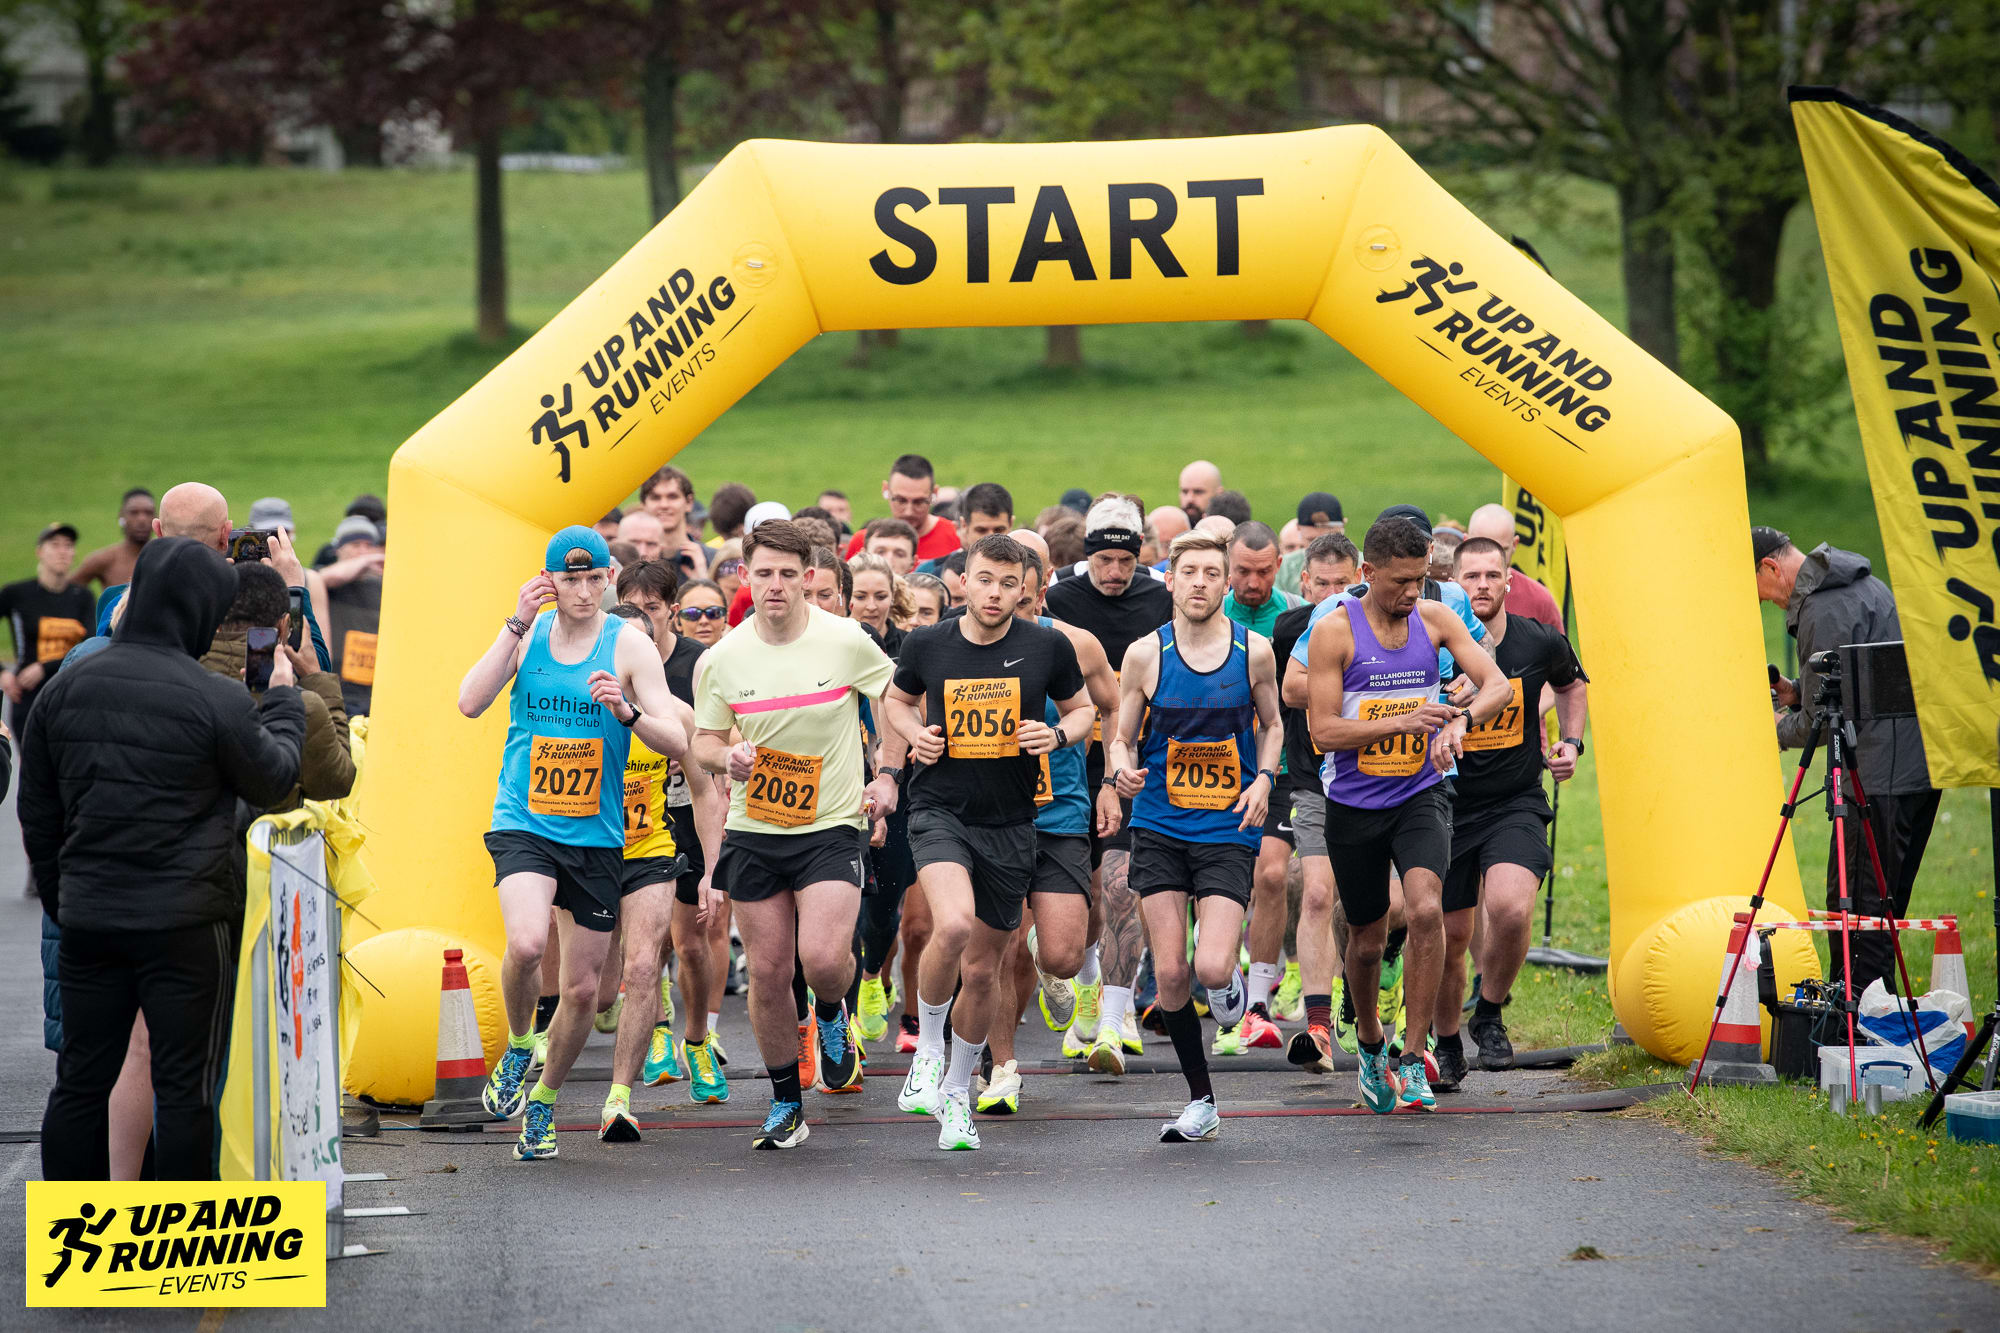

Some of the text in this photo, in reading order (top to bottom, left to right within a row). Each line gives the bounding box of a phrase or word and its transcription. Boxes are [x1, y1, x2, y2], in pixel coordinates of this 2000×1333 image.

[869, 178, 1264, 285] START
[576, 268, 695, 389] UP AND
[1477, 290, 1612, 391] UP AND
[585, 276, 736, 433] RUNNING
[650, 343, 716, 415] EVENTS
[1433, 307, 1611, 432] RUNNING
[1459, 367, 1541, 422] EVENTS
[1909, 247, 2000, 566] NNING
[1869, 293, 1979, 566] UP AND
[971, 682, 1006, 692] UP AND
[1370, 670, 1426, 681] BELLAHOUSTON
[528, 692, 601, 715] Lothian
[967, 689, 1012, 701] RUNNING
[1385, 701, 1419, 711] UP AND
[528, 712, 600, 728] Running Club
[950, 708, 1016, 737] 2056
[551, 750, 596, 760] RUNNING
[569, 742, 591, 750] AND
[772, 762, 814, 774] RUNNING
[776, 756, 811, 767] UP AND
[1172, 762, 1236, 790] 2055
[534, 766, 599, 796] 2027
[750, 773, 815, 810] 2082
